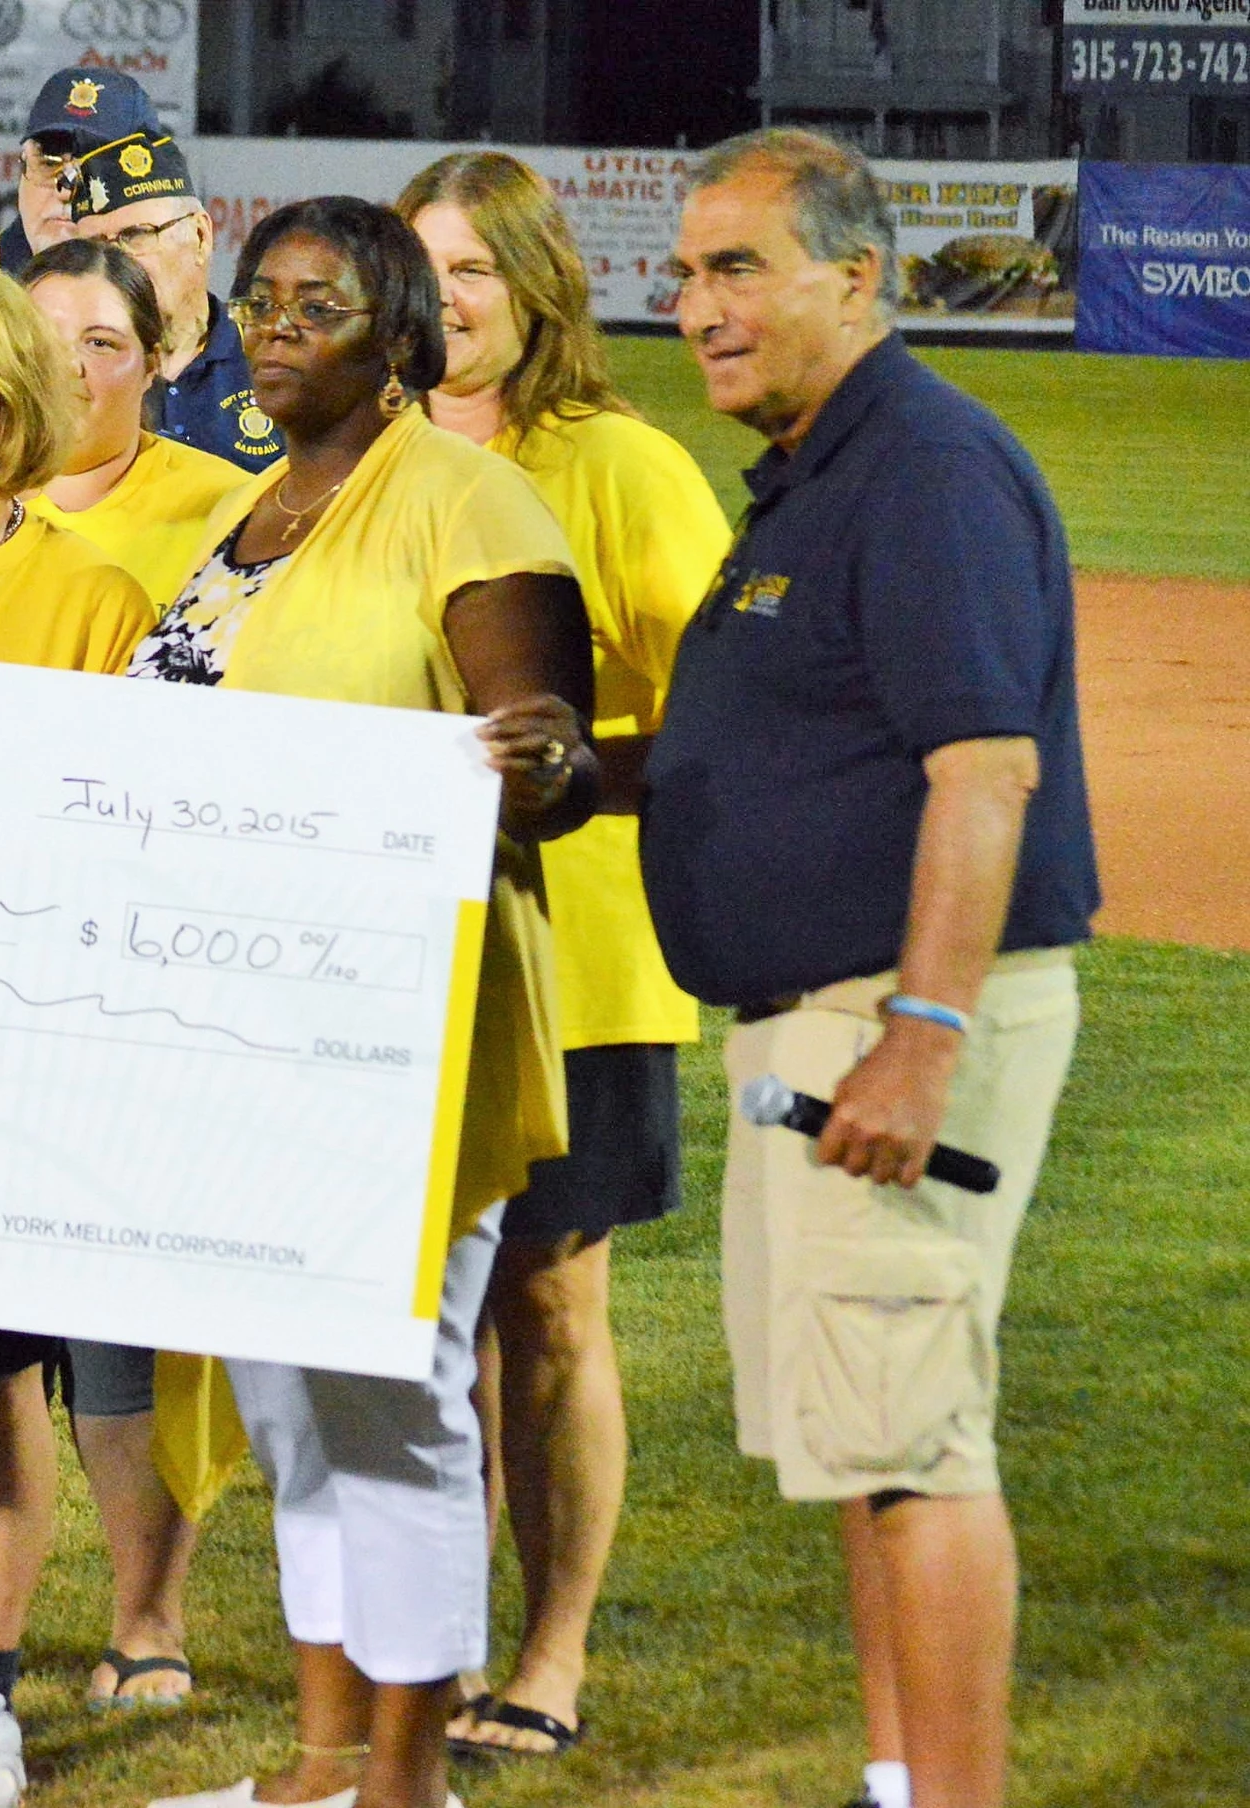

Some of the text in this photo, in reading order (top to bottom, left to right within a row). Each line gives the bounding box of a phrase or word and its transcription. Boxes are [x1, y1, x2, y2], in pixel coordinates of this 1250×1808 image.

[1185, 0, 1250, 21] Agenc
[122, 179, 174, 198] CORNING,
[1099, 223, 1137, 245] The
[1143, 224, 1219, 248] Reason
[234, 441, 279, 455] BASEBALL
[61, 777, 153, 851] July
[383, 830, 436, 855] DATE
[80, 919, 99, 947] $
[129, 911, 283, 969] 6,000
[313, 1038, 413, 1068] DOLLARS
[2, 1211, 57, 1238] YORK
[63, 1219, 152, 1250] MELLON
[155, 1229, 307, 1269] CORPORATION
